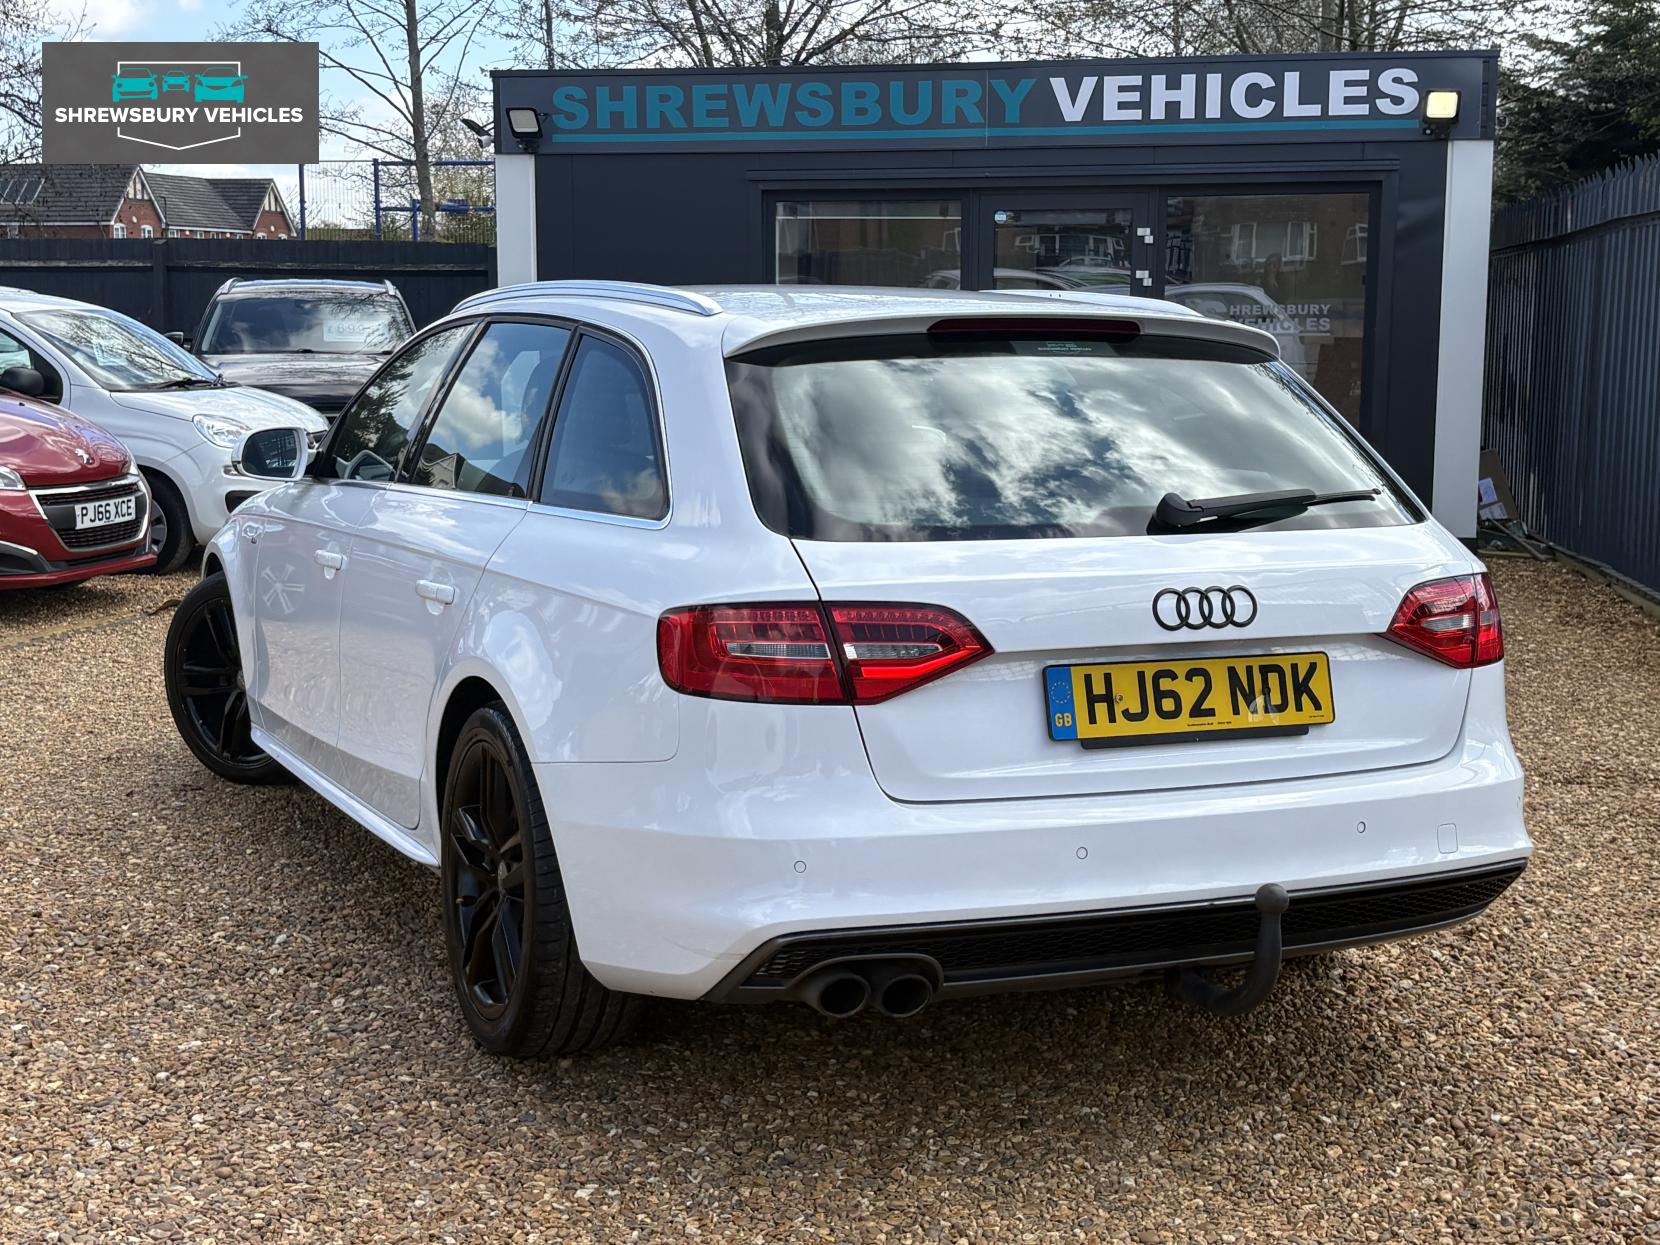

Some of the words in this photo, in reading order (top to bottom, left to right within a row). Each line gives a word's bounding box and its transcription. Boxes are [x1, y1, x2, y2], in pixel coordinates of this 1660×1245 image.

[552, 78, 1038, 130] SHREWSBURY
[1049, 67, 1420, 122] VEHICLES
[80, 502, 112, 525] PJ66
[113, 498, 132, 520] XCE
[1083, 667, 1217, 725] HJ62
[1227, 661, 1324, 716] NDK
[1055, 712, 1073, 728] GB
